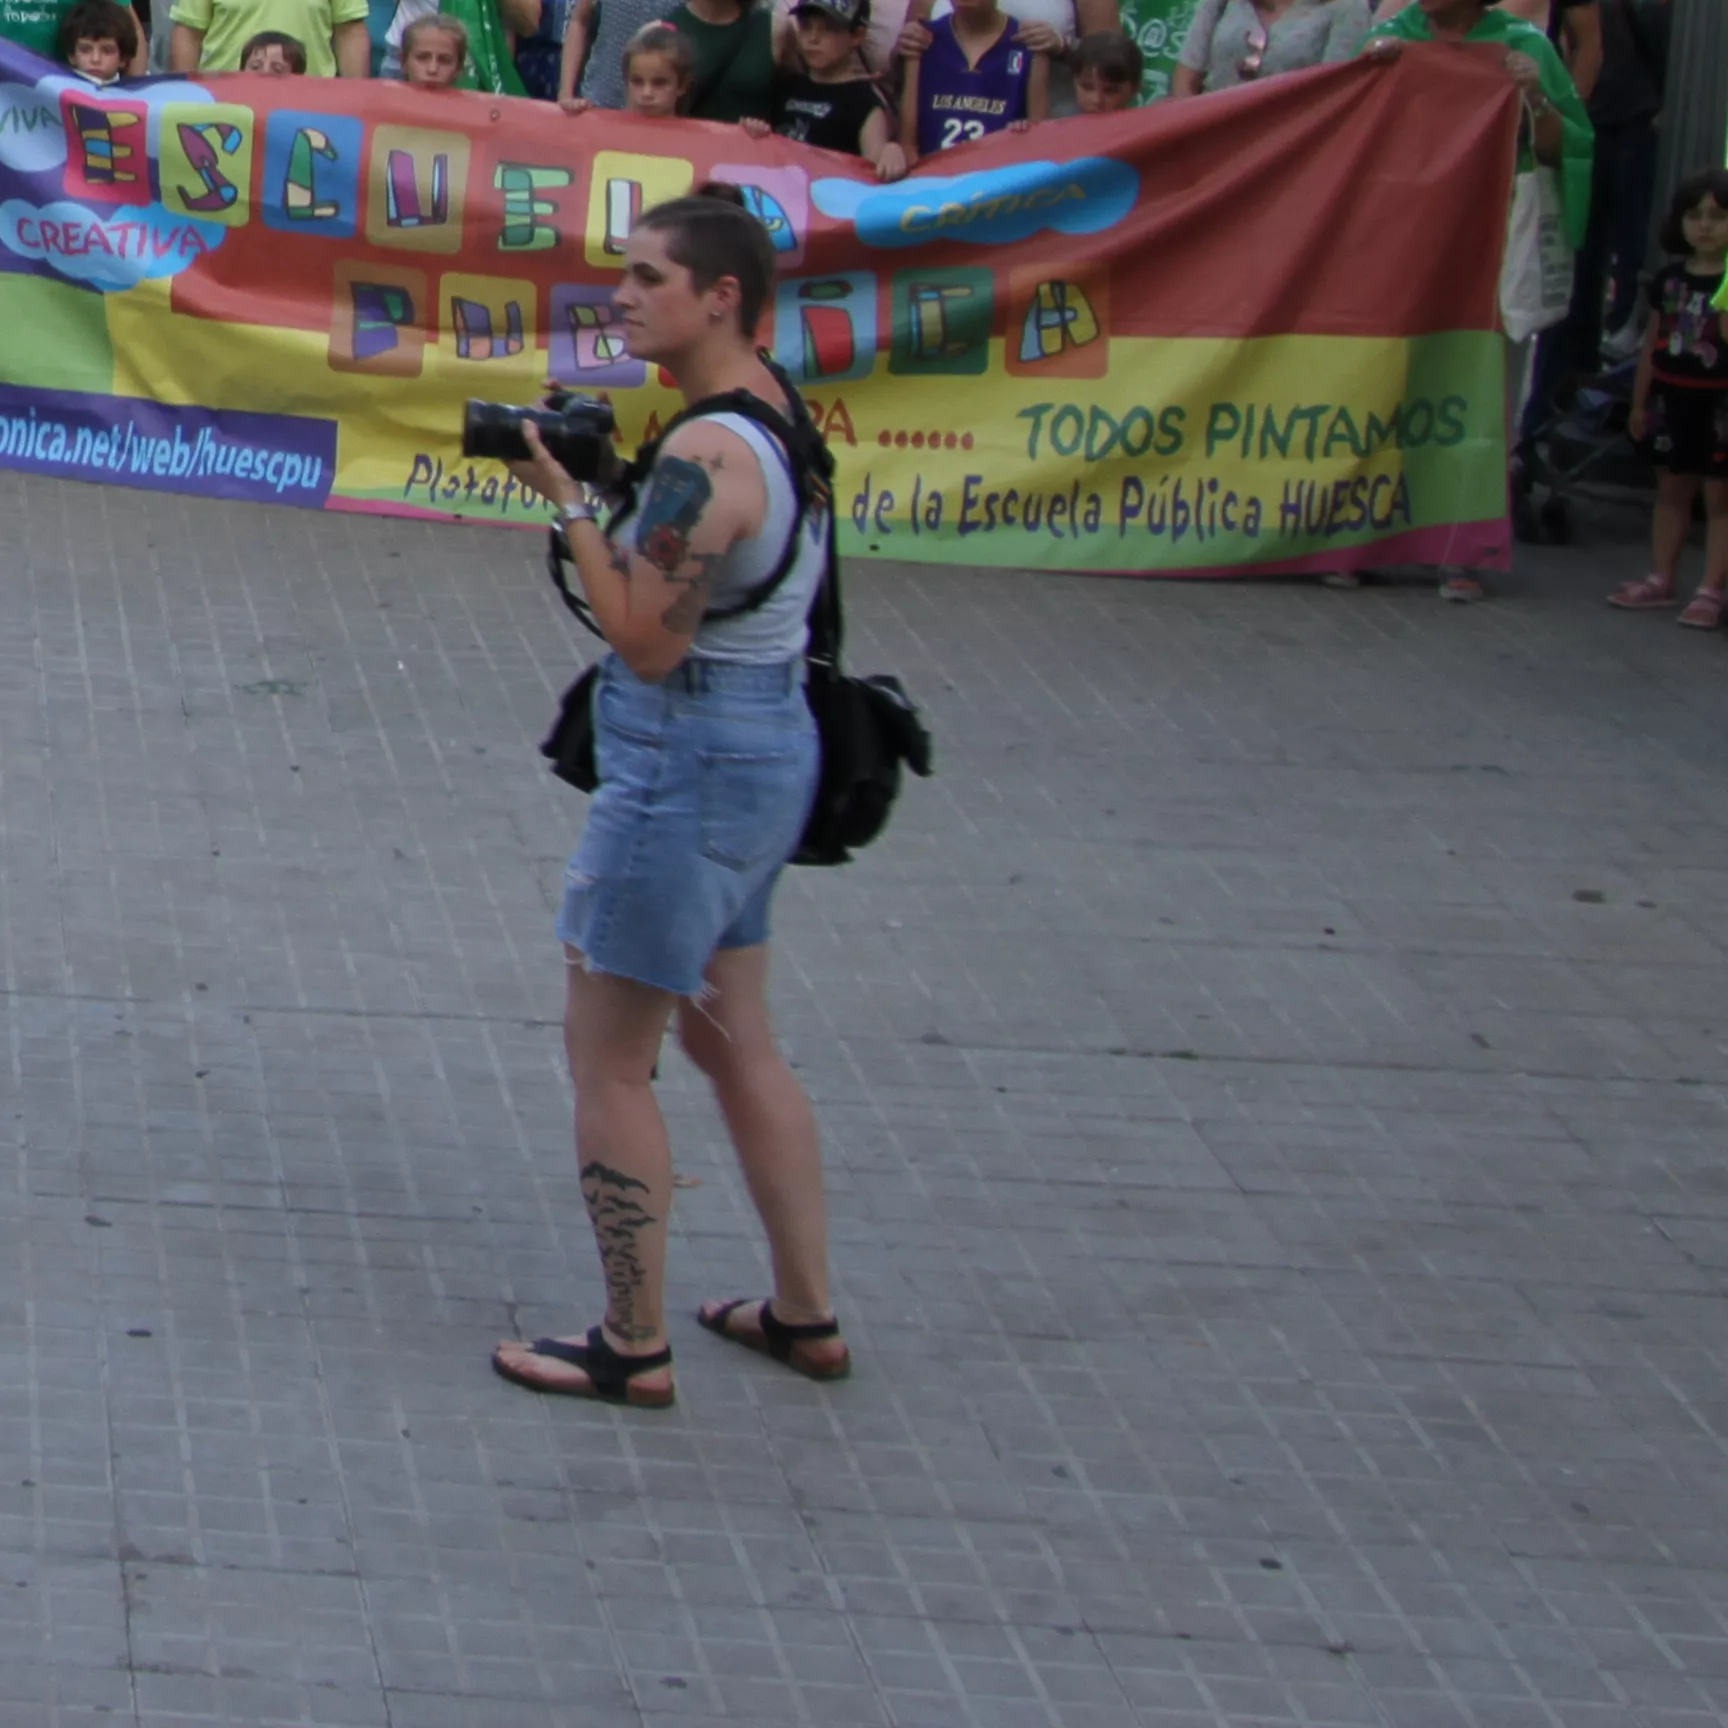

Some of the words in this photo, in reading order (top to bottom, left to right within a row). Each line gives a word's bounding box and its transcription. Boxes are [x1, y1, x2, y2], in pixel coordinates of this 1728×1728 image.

[16, 217, 210, 260] CREATIVA
[1016, 402, 1187, 462] TODOS
[1204, 395, 1468, 464] PINTAMOS
[851, 472, 895, 536] de
[910, 473, 943, 536] la
[957, 474, 1102, 540] Escuela
[1119, 475, 1262, 544] Pública
[1279, 472, 1412, 539] HUESCA
